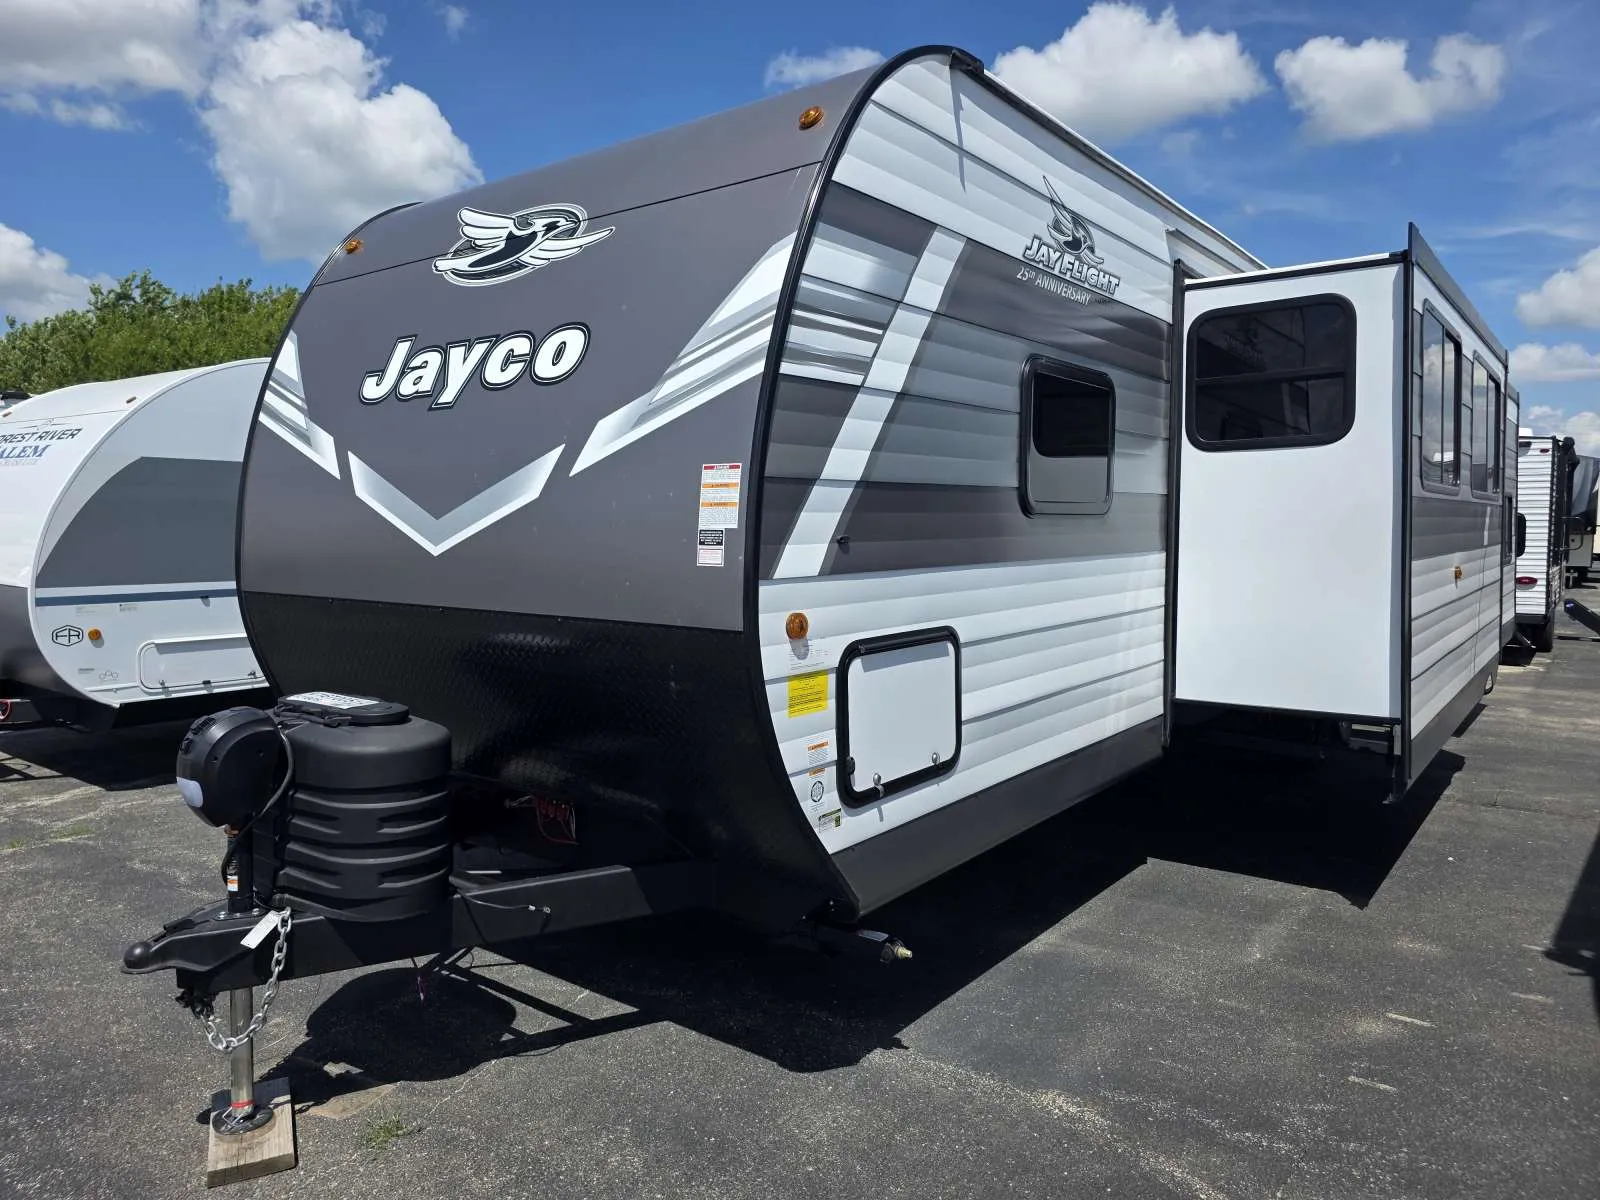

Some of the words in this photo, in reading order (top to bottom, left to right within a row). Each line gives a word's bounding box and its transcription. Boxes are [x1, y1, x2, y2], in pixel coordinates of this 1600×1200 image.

[1035, 273, 1091, 305] ANNIVERSARY
[359, 322, 591, 411] Jayco
[34, 428, 83, 441] RIVER
